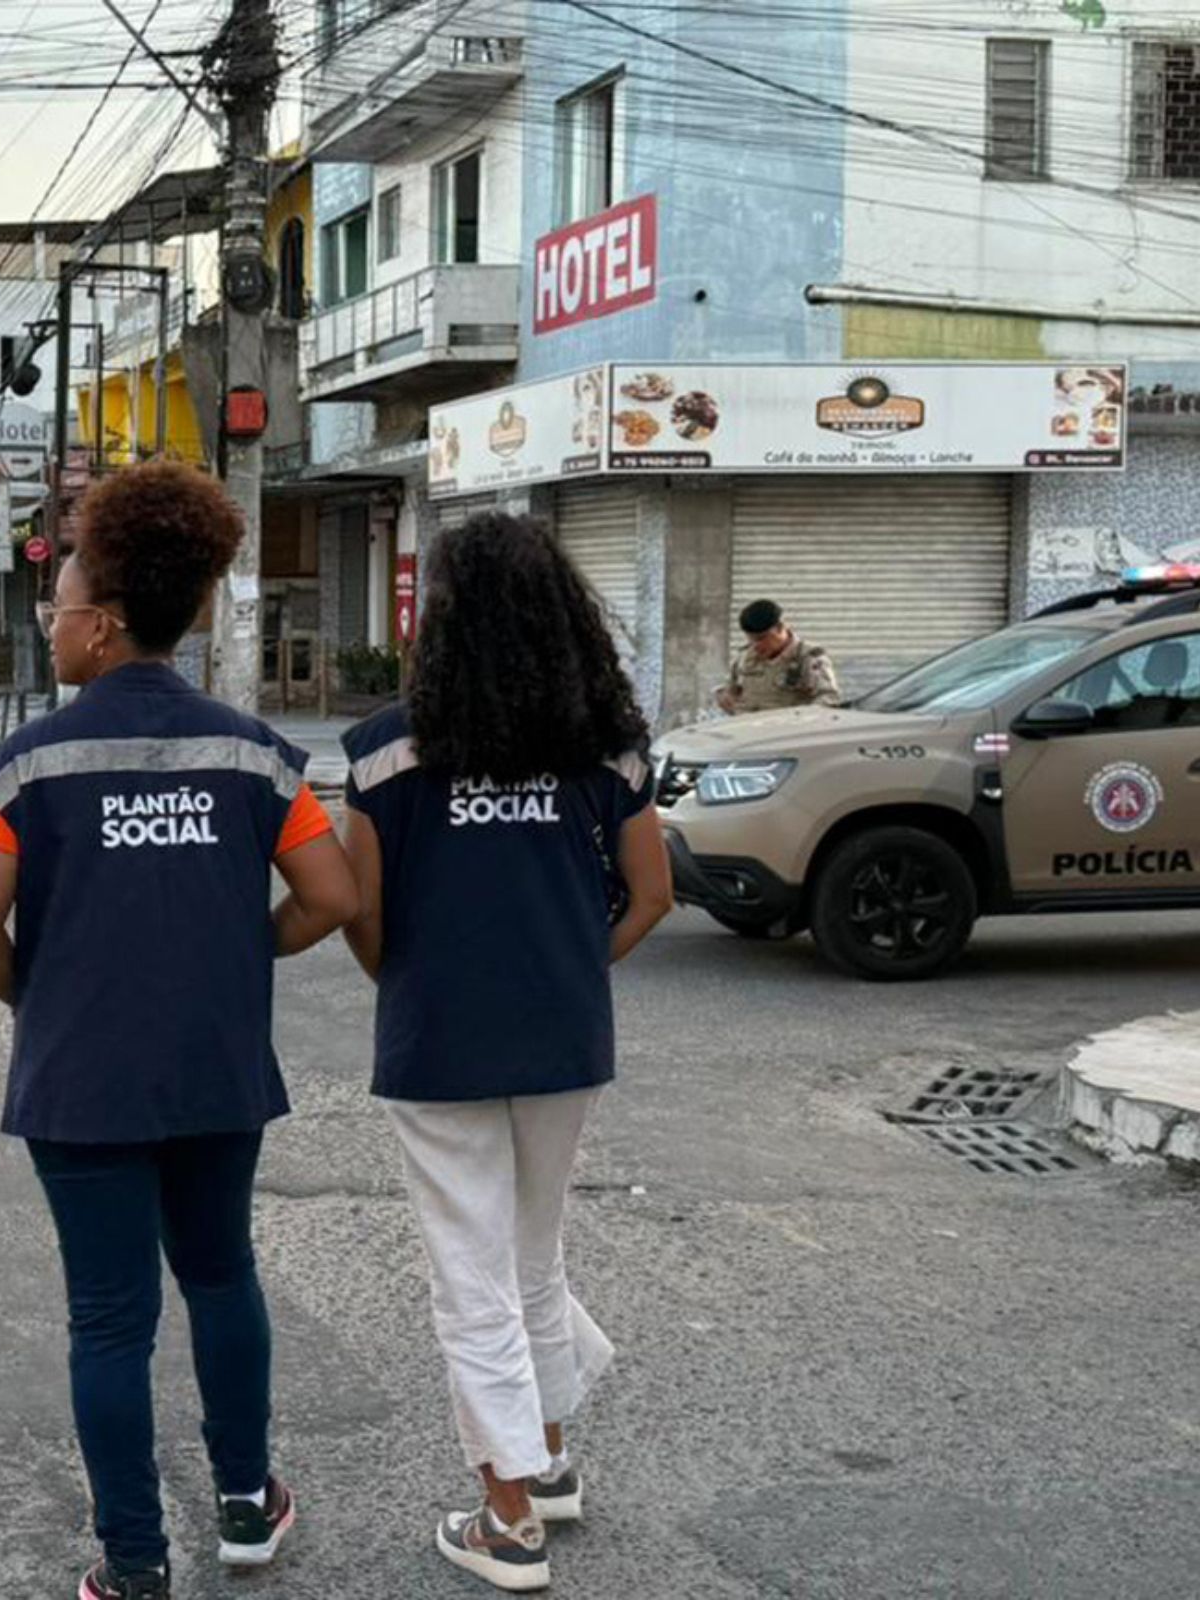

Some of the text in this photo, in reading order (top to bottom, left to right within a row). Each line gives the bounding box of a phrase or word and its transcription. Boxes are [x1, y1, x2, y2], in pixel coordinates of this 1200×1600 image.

[536, 211, 652, 322] HOTEL
[764, 450, 793, 463] Café
[816, 451, 858, 463] manhã
[929, 451, 973, 463] Lanche
[880, 744, 926, 759] 190
[102, 786, 214, 817] PLANTÃO
[449, 794, 561, 826] SOCIAL
[101, 815, 219, 848] SOCIAL
[1052, 844, 1194, 876] POLÍCIA
